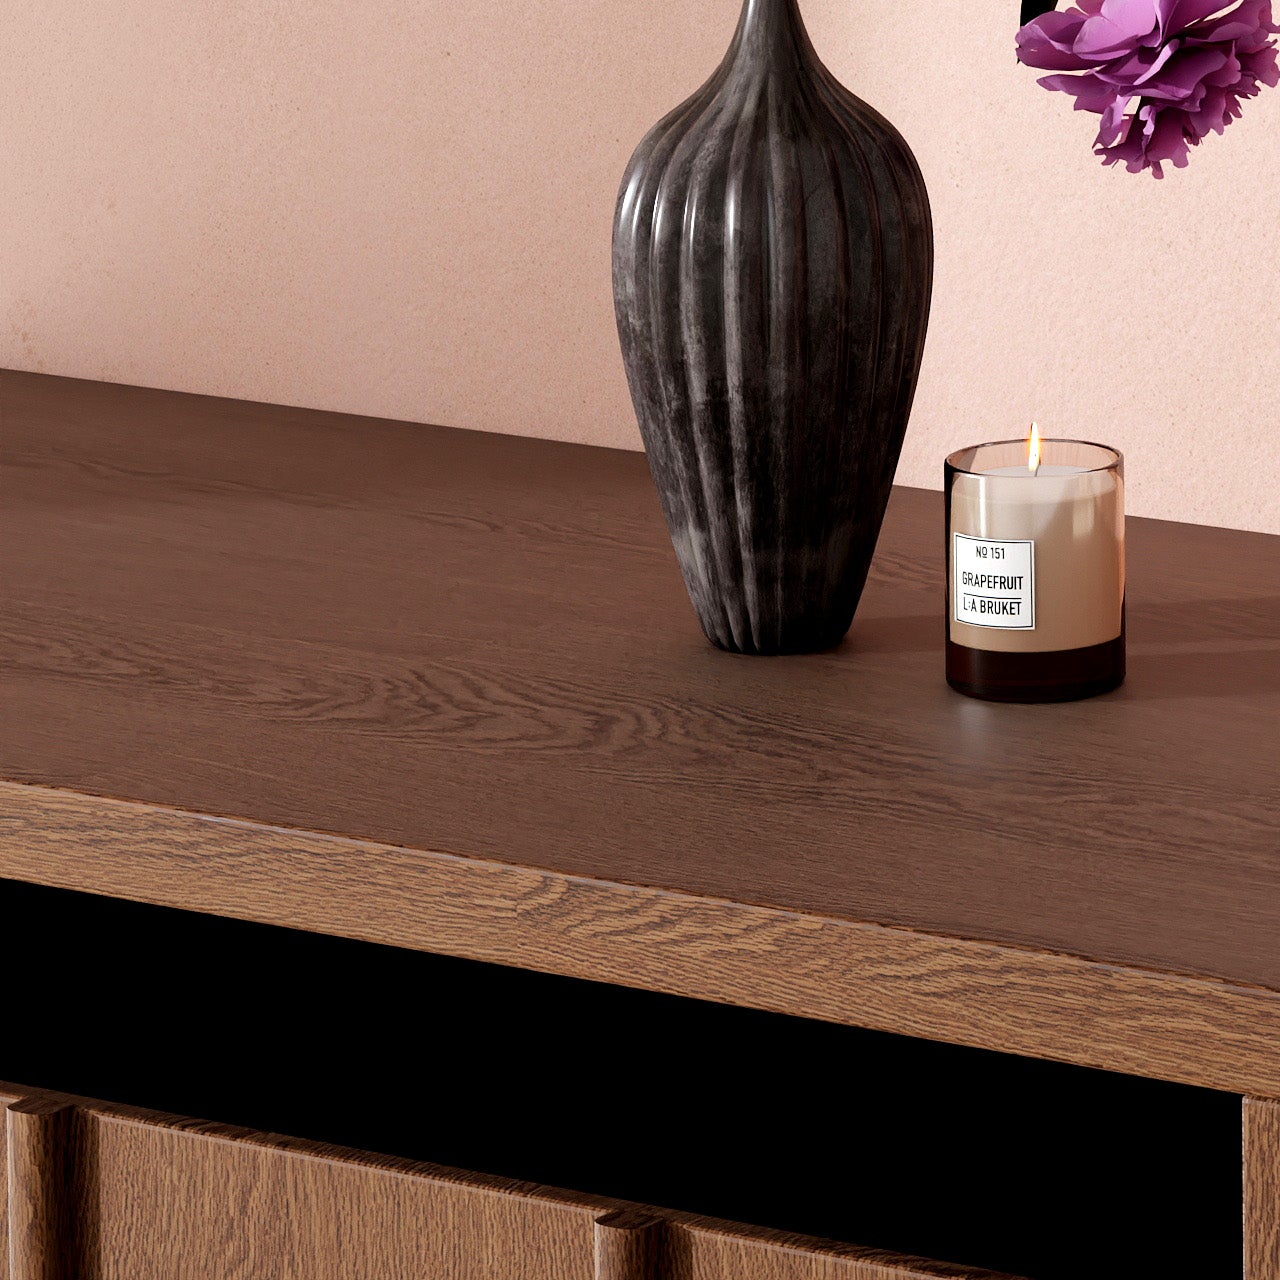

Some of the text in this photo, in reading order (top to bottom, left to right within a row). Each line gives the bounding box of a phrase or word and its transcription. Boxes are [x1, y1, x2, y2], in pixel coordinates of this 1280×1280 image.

[990, 547, 1005, 559] 151
[962, 571, 1024, 590] GRAPEFRUIT
[980, 599, 1022, 615] BRUKET
